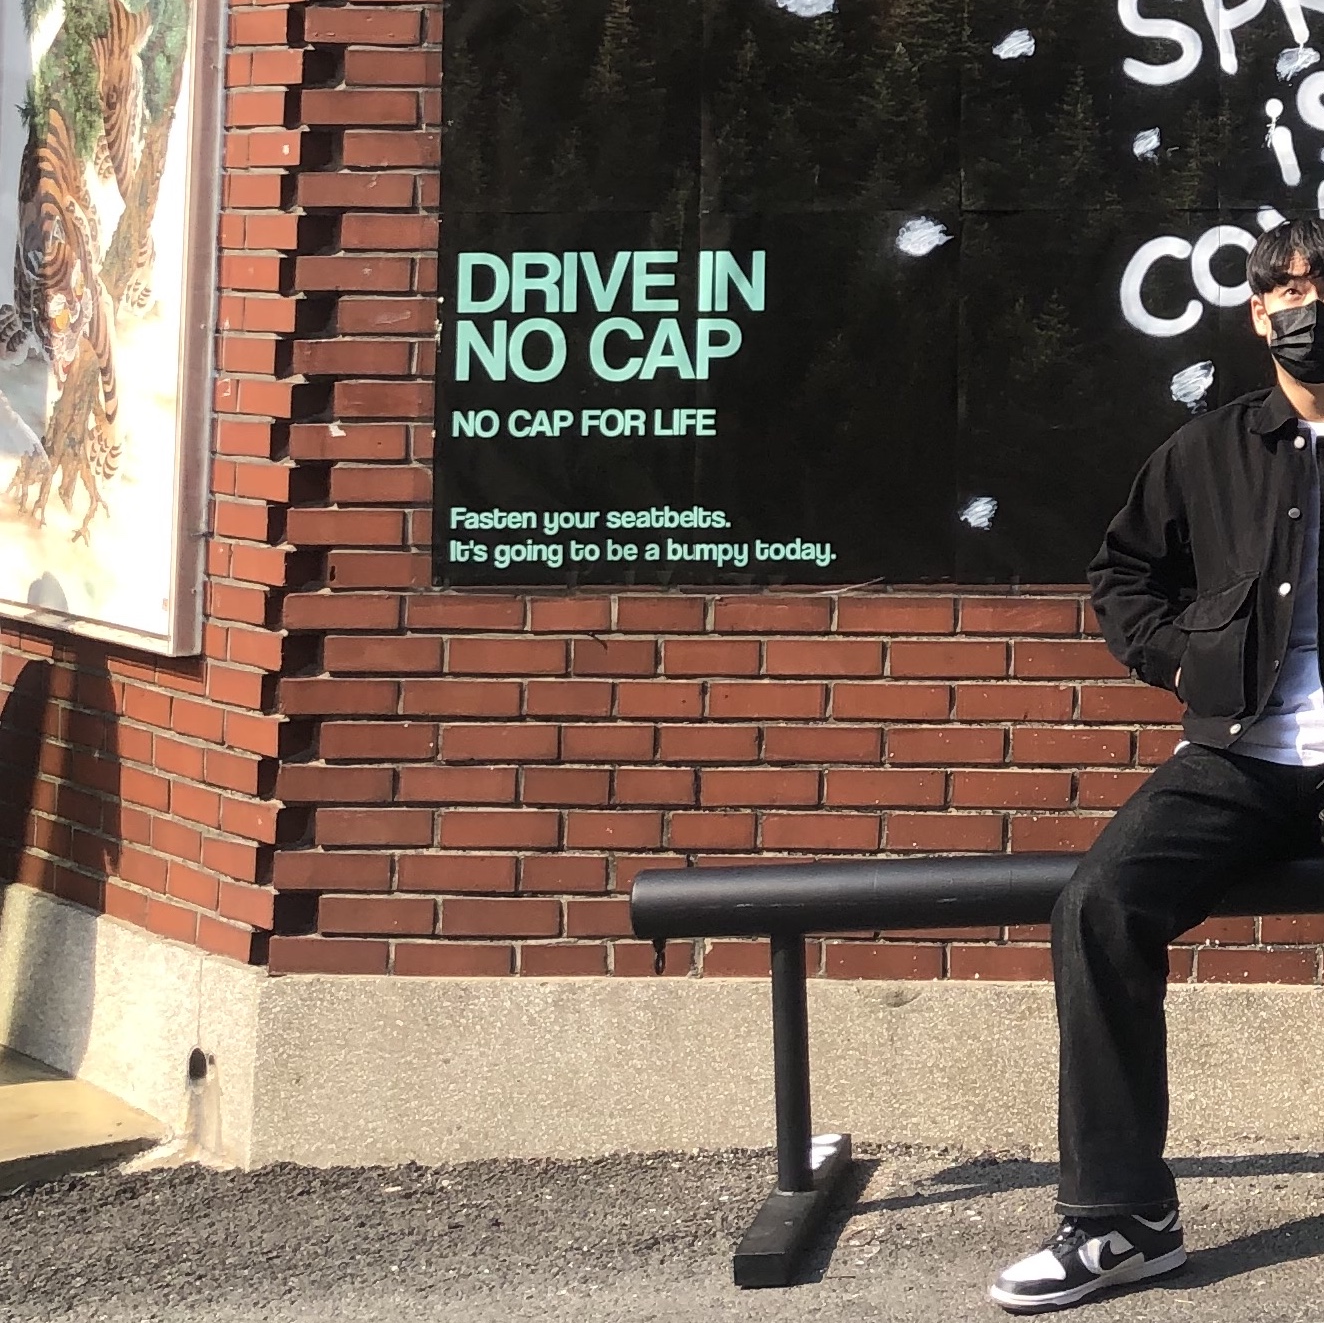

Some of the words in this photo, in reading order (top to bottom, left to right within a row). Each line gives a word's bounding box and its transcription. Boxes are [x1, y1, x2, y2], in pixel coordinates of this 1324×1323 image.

[457, 250, 679, 314] DRIVE
[698, 250, 766, 313] IN
[455, 317, 567, 383] NO
[589, 316, 743, 383] CAP
[452, 409, 500, 439] NO
[507, 409, 574, 438] CAP
[581, 408, 646, 437] FOR
[653, 408, 717, 437] LIFE
[450, 506, 538, 530] Fasten
[542, 511, 600, 536] your
[605, 505, 732, 529] seatbelts.
[449, 539, 488, 563] It's
[493, 538, 563, 569] going
[569, 539, 600, 562] to
[606, 538, 638, 561] be
[644, 543, 660, 561] a
[666, 537, 749, 568] bumpy
[755, 537, 837, 567] today.
